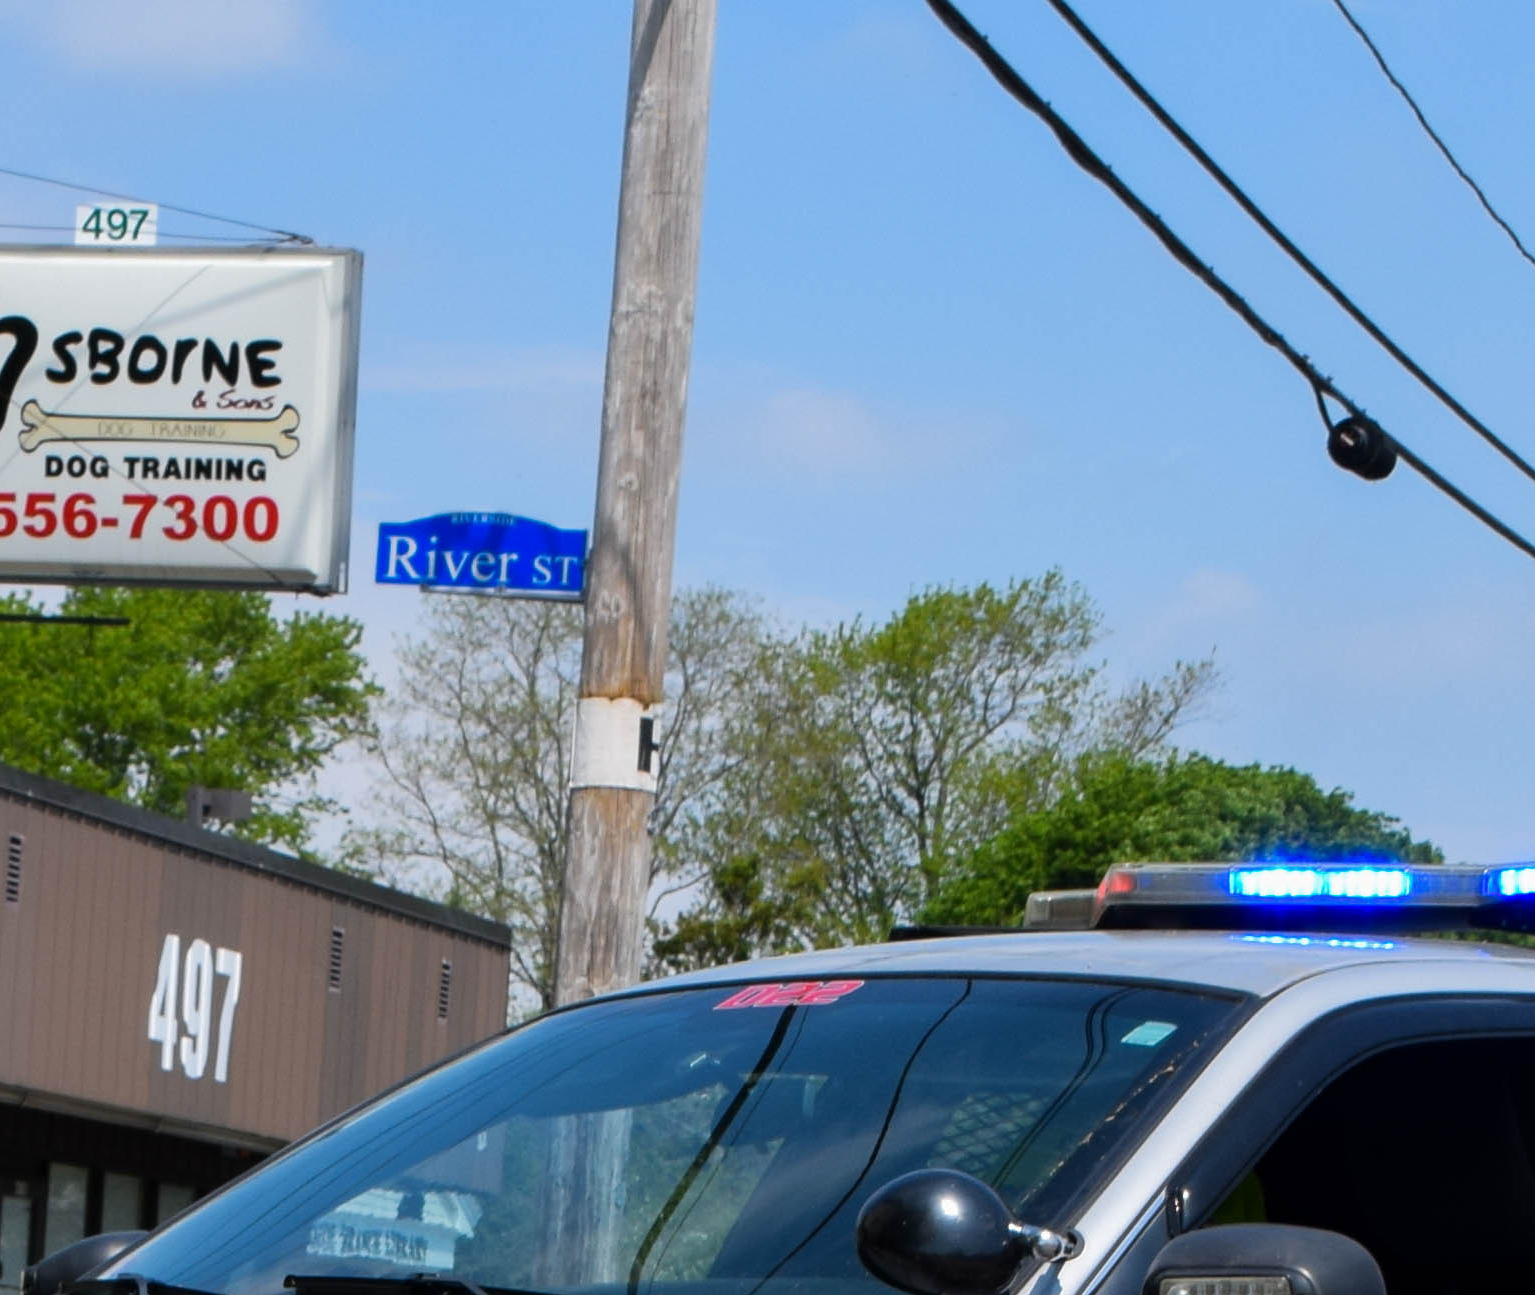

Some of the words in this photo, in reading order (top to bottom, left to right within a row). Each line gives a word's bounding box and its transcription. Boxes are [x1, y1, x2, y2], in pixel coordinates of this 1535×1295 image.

[81, 208, 150, 241] 497
[192, 390, 207, 409] &
[216, 387, 276, 410] Sons
[97, 422, 134, 437] DOG
[150, 422, 226, 439] TRAINING
[45, 456, 110, 479] DOG
[125, 456, 267, 482] TRAINING
[385, 535, 519, 582] River
[532, 554, 579, 586] ST
[148, 933, 243, 1083] 497
